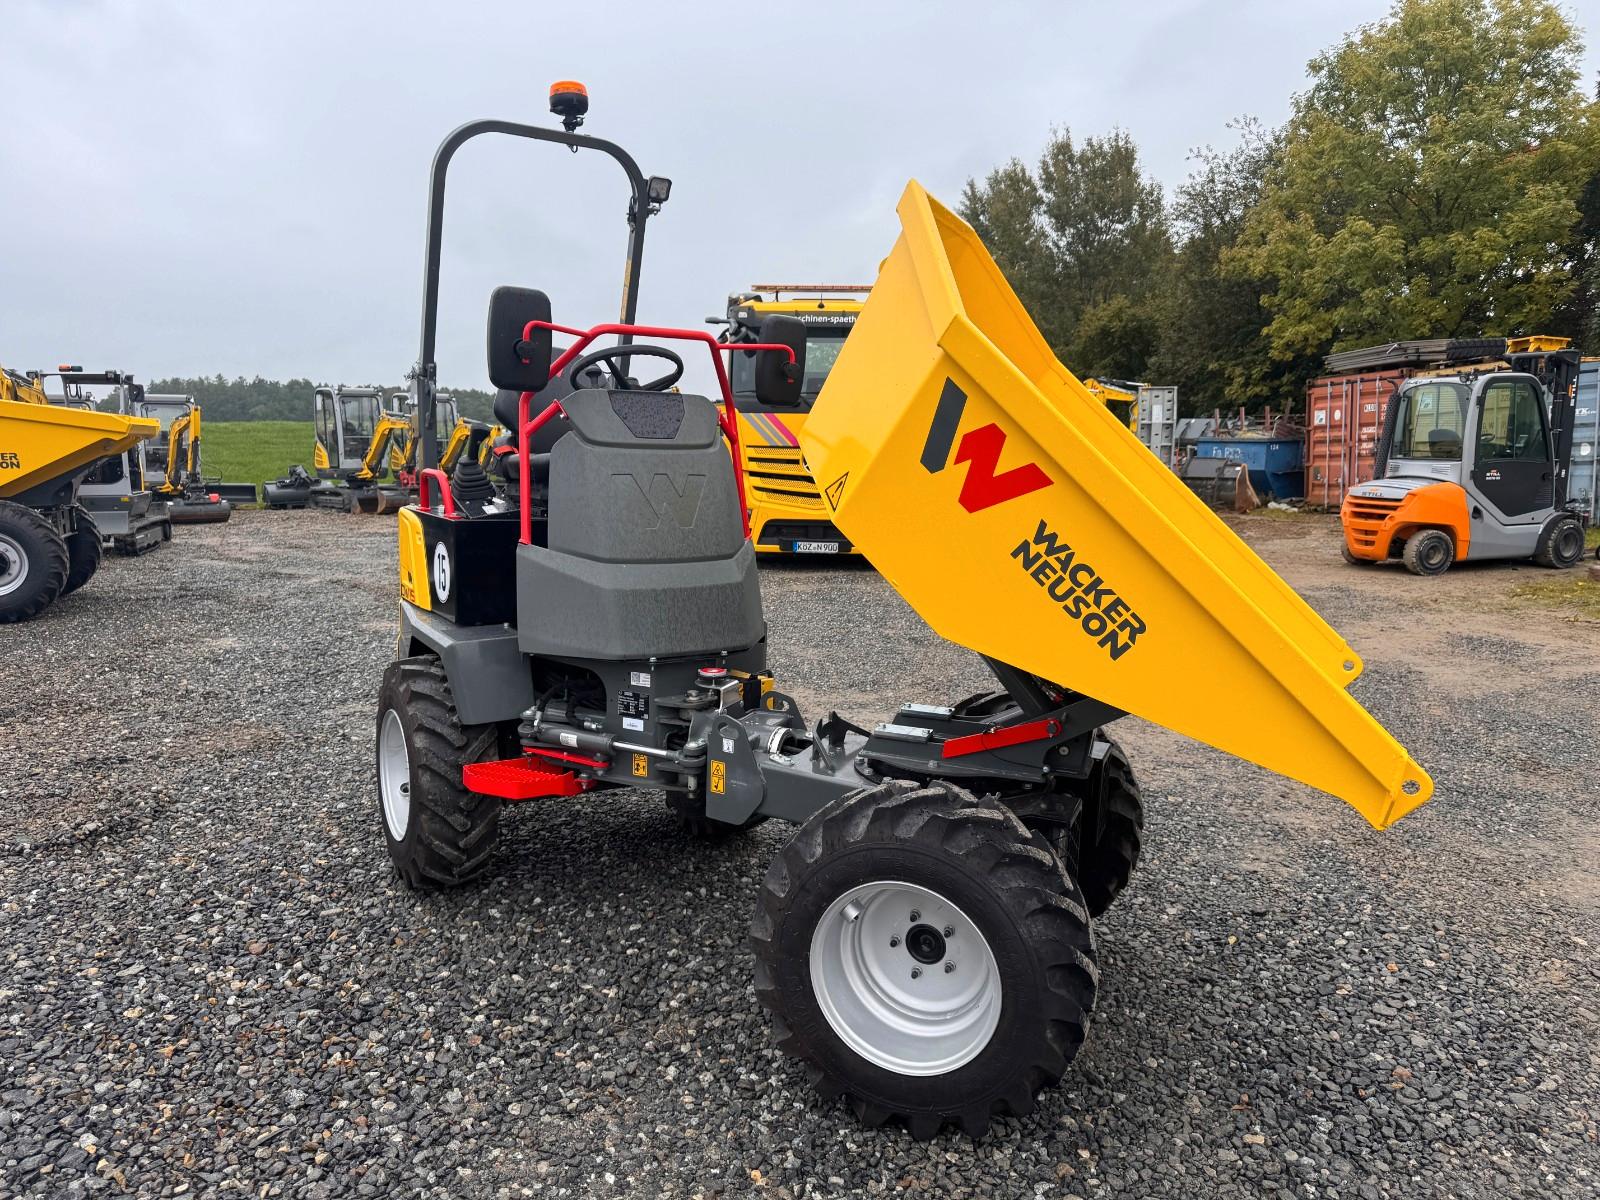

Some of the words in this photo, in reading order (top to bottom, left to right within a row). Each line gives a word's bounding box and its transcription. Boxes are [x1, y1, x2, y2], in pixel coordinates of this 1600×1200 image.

[437, 552, 447, 592] 15
[1010, 539, 1133, 661] NEUSON
[1032, 518, 1146, 644] WACKER
